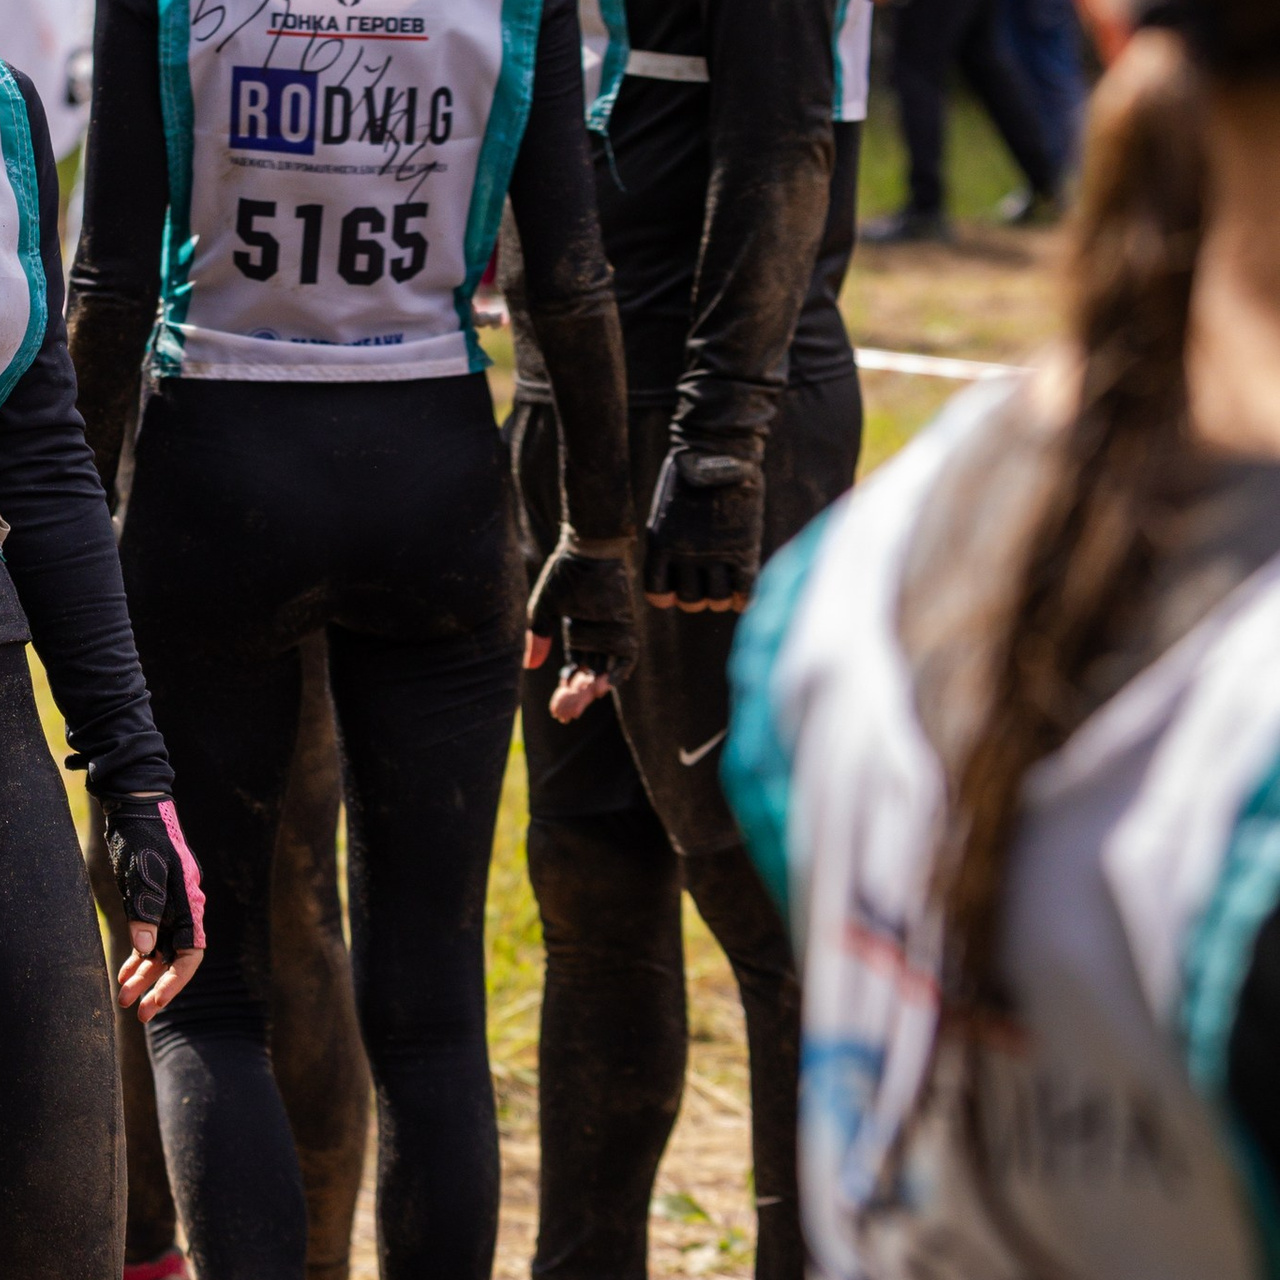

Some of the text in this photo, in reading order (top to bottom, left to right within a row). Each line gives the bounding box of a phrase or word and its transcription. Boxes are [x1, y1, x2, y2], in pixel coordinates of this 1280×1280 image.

[271, 12, 426, 34] ГОНКА ГЕРОЕВ
[238, 80, 454, 146] RODVIG
[233, 197, 430, 287] 5165
